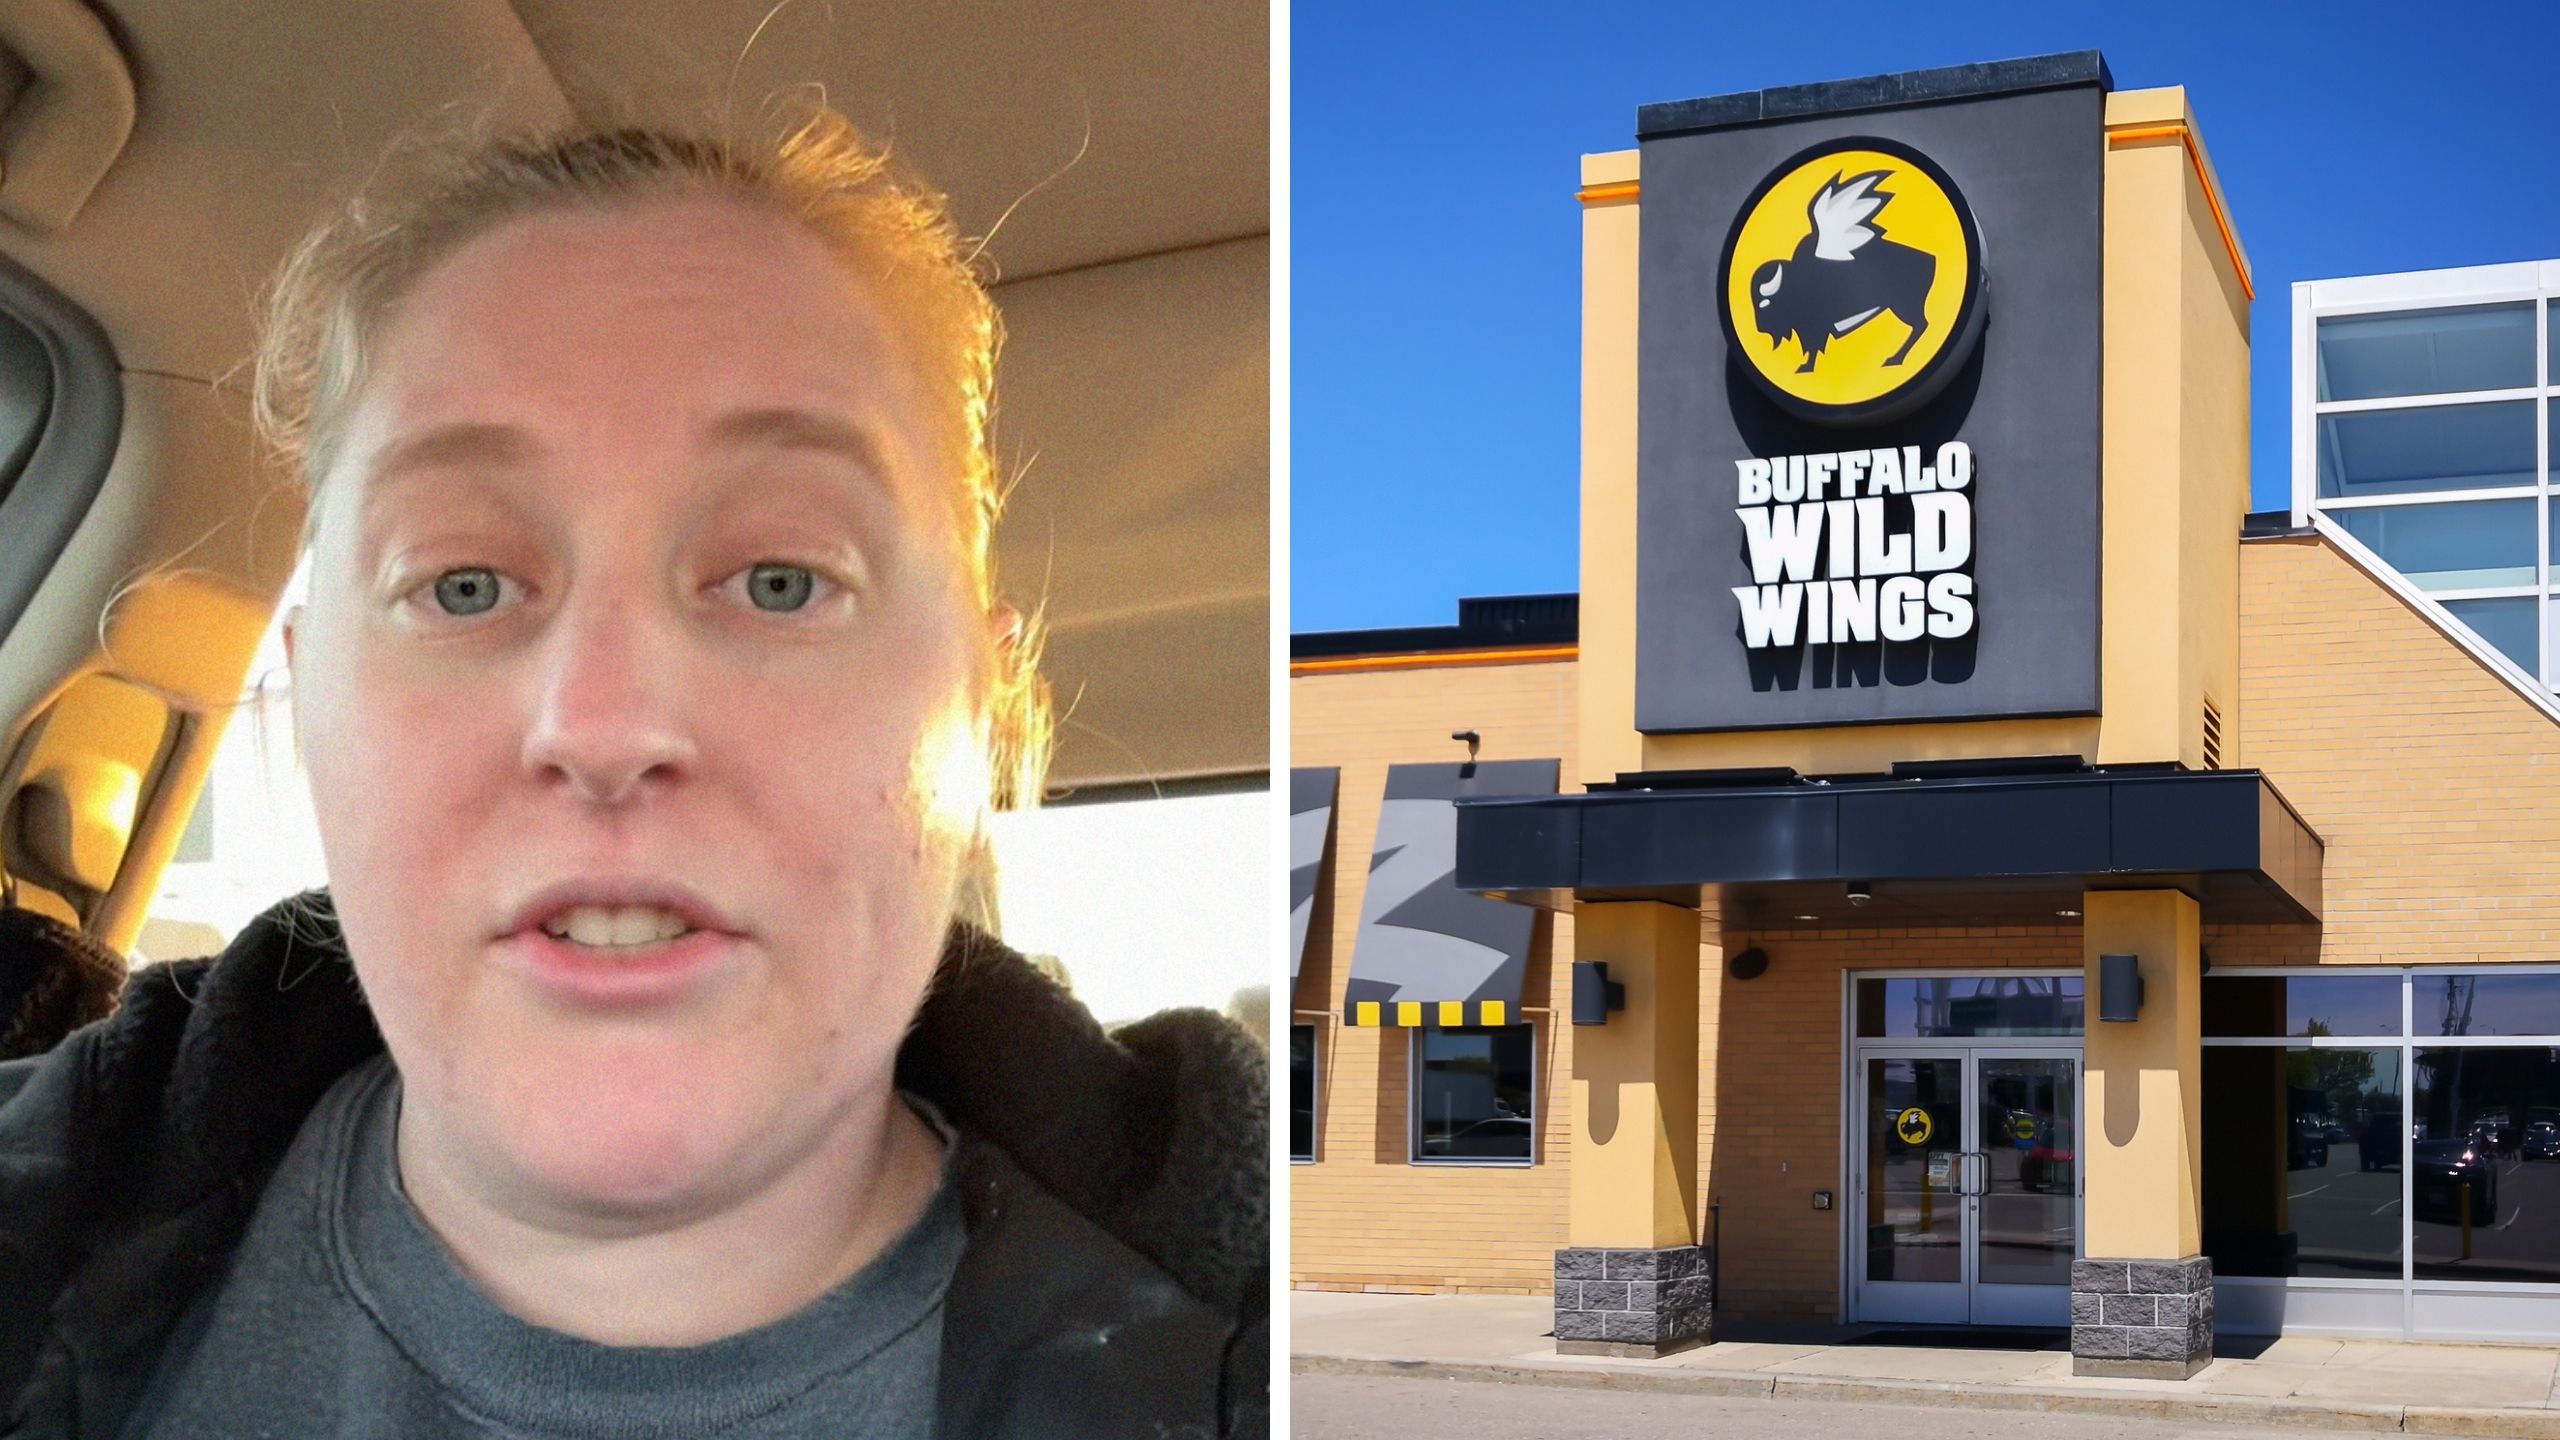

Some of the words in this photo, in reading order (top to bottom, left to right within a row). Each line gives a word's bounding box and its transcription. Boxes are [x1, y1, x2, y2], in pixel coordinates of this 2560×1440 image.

[1734, 441, 1971, 505] BUFFALO
[1734, 491, 1971, 584] WILD
[1731, 572, 1974, 648] WINGS
